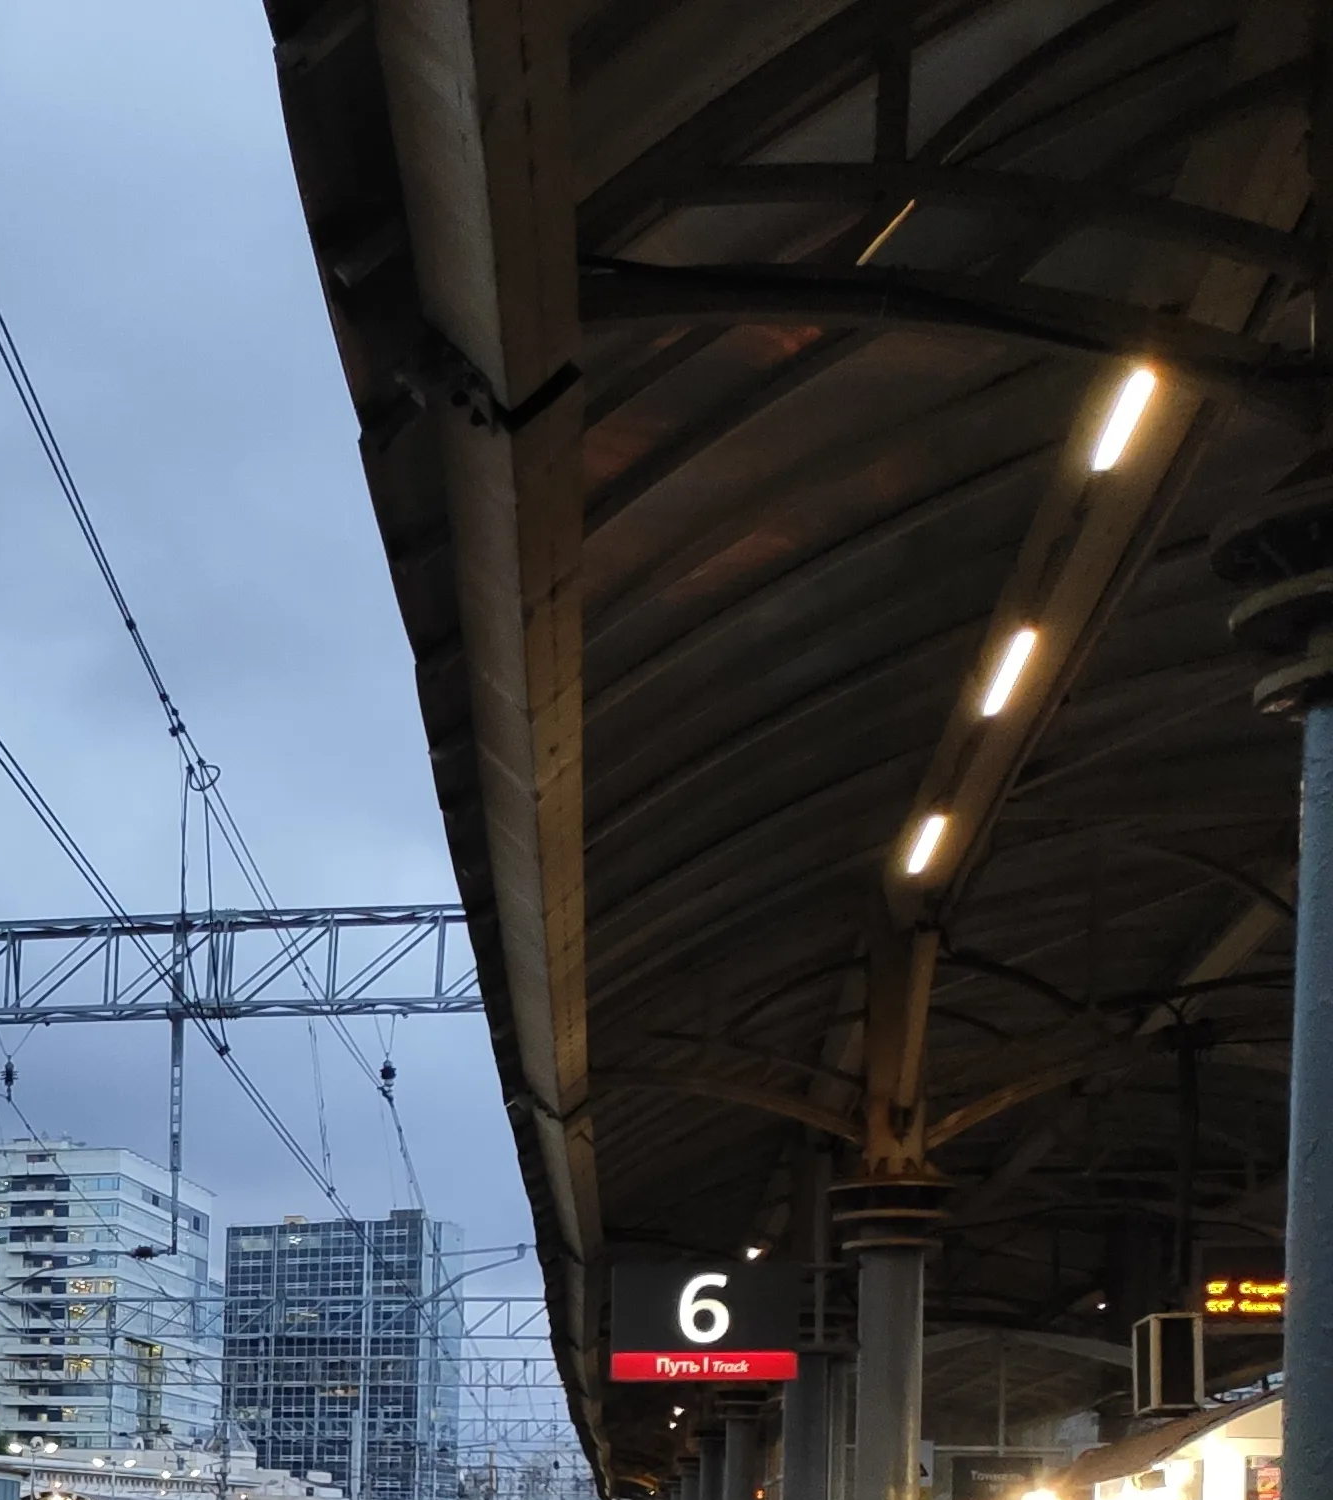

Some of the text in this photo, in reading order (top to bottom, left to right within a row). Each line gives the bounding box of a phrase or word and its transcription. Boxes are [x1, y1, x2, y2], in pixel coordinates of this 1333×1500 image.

[679, 1273, 730, 1344] 6
[655, 1356, 750, 1377] Путь Track
